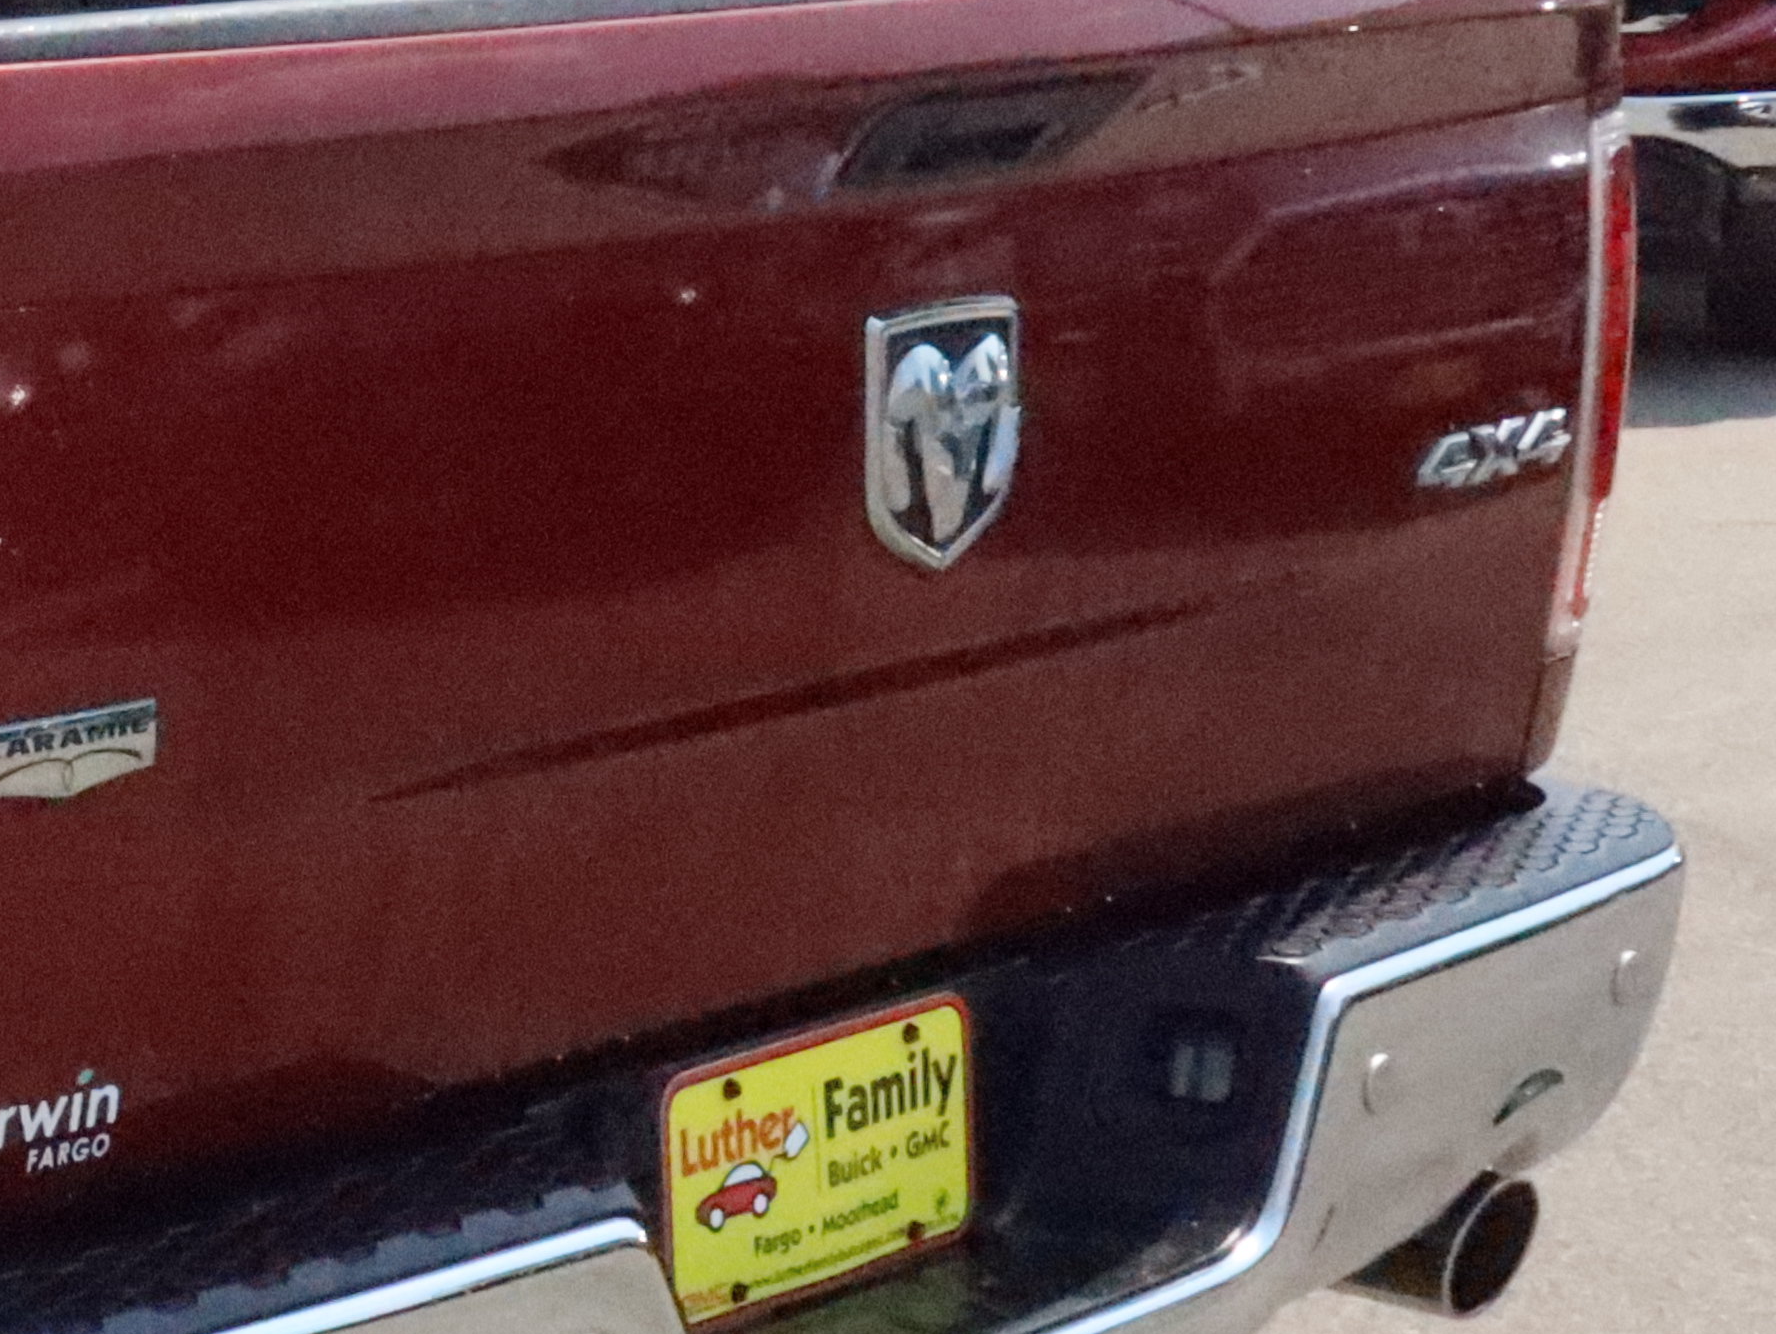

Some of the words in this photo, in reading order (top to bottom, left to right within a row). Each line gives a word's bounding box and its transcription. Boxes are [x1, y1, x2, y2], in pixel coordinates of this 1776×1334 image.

[824, 1047, 957, 1139] Family
[26, 1133, 111, 1174] FARGO
[680, 1105, 794, 1177] Luther
[827, 1146, 883, 1188] Buick
[905, 1119, 950, 1159] GMC
[754, 1228, 802, 1257] Fargo
